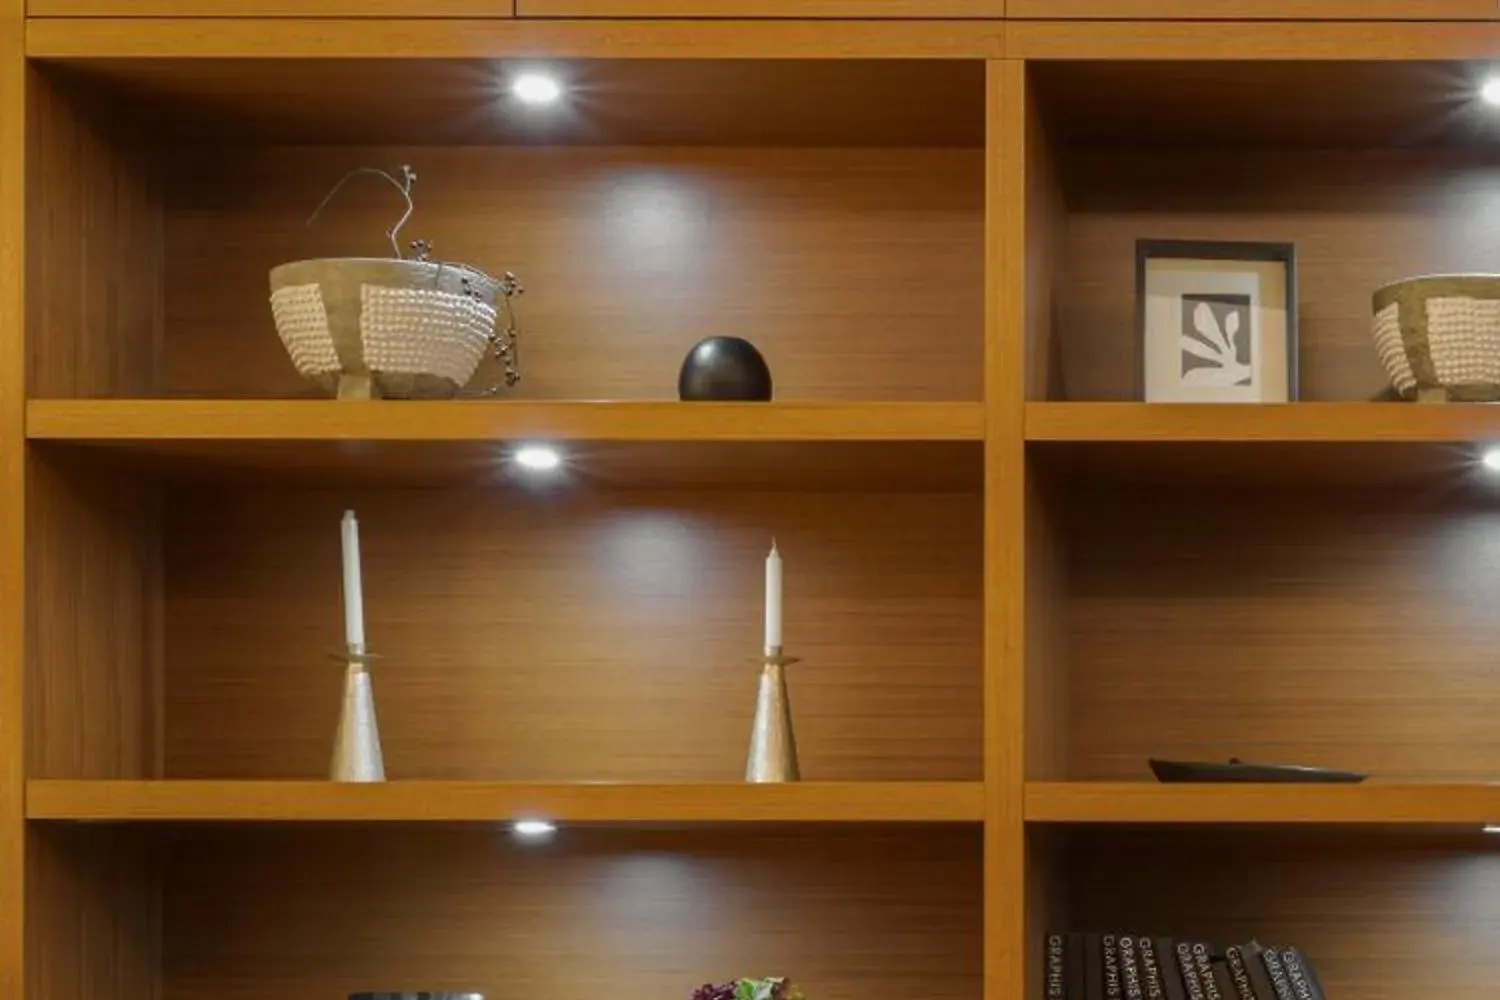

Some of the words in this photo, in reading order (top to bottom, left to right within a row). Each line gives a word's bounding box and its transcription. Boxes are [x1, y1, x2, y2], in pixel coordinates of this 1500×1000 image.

[1048, 935, 1062, 996] GRAPHIS
[1102, 935, 1121, 996] GRAPHIS
[1119, 936, 1142, 996] GRAPHIS
[1138, 936, 1162, 998] GRAPHIS
